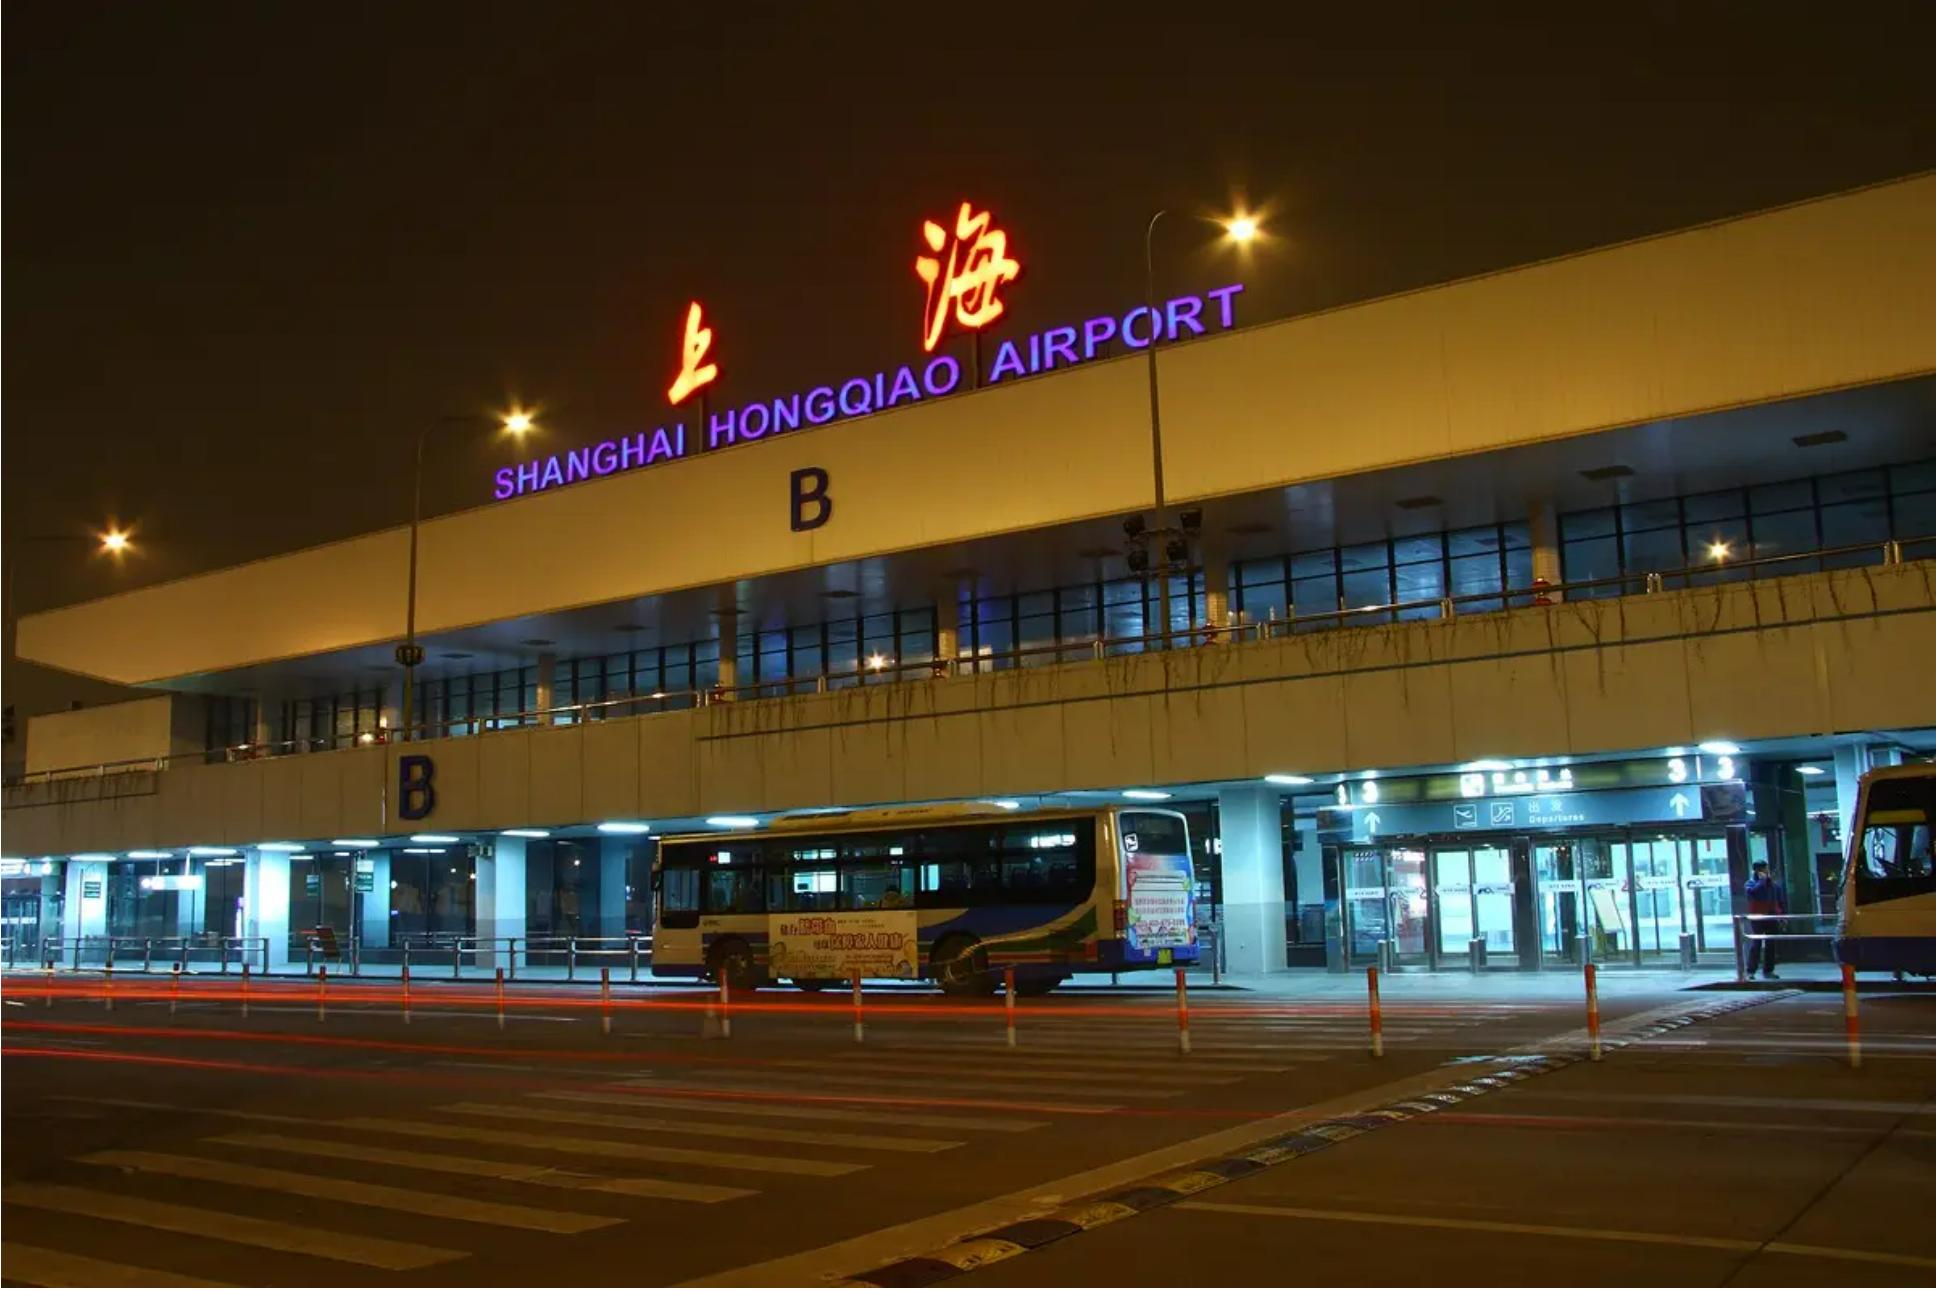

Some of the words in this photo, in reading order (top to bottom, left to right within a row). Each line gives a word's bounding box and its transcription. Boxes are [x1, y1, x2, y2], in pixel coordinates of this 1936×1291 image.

[494, 423, 686, 500] SHANGHAI
[709, 355, 960, 448] HONGQIAO
[989, 283, 1244, 382] AIRPORT
[790, 466, 832, 532] B
[399, 755, 435, 820] B
[1667, 758, 1687, 783] 3
[1717, 756, 1736, 780] 3
[1529, 813, 1584, 825] Departures
